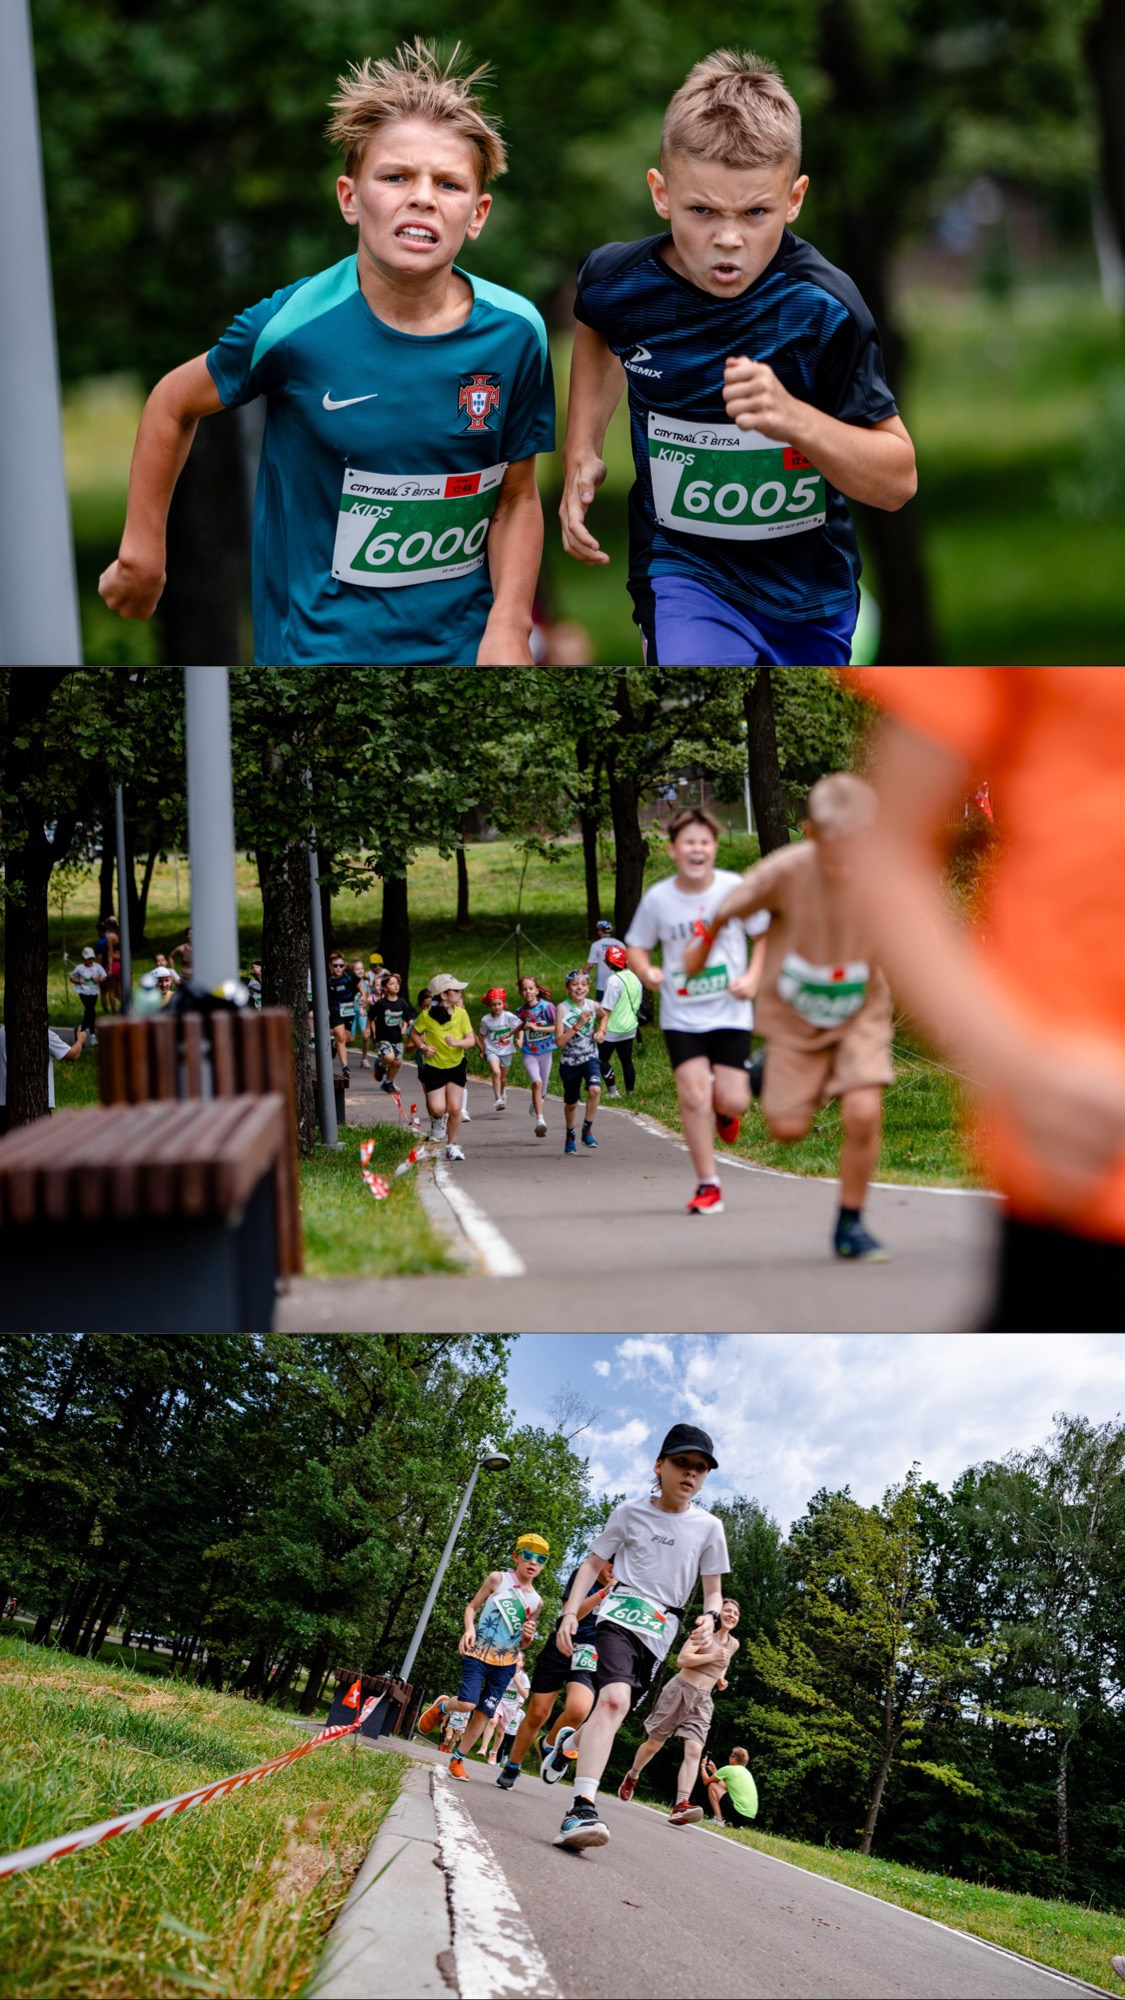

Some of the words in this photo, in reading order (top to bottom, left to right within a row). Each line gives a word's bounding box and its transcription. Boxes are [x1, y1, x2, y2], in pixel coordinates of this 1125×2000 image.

[624, 360, 663, 379] DEMIX
[700, 435, 708, 445] 3
[710, 438, 740, 446] BITSA
[658, 448, 696, 466] KIDS
[401, 487, 411, 497] 3
[412, 488, 440, 497] BITSA
[683, 474, 821, 518] 6005
[350, 502, 393, 520] KIDS
[364, 517, 490, 566] 6000
[651, 1535, 675, 1546] FILA
[502, 1600, 521, 1630] 6040
[613, 1608, 663, 1630] 6034
